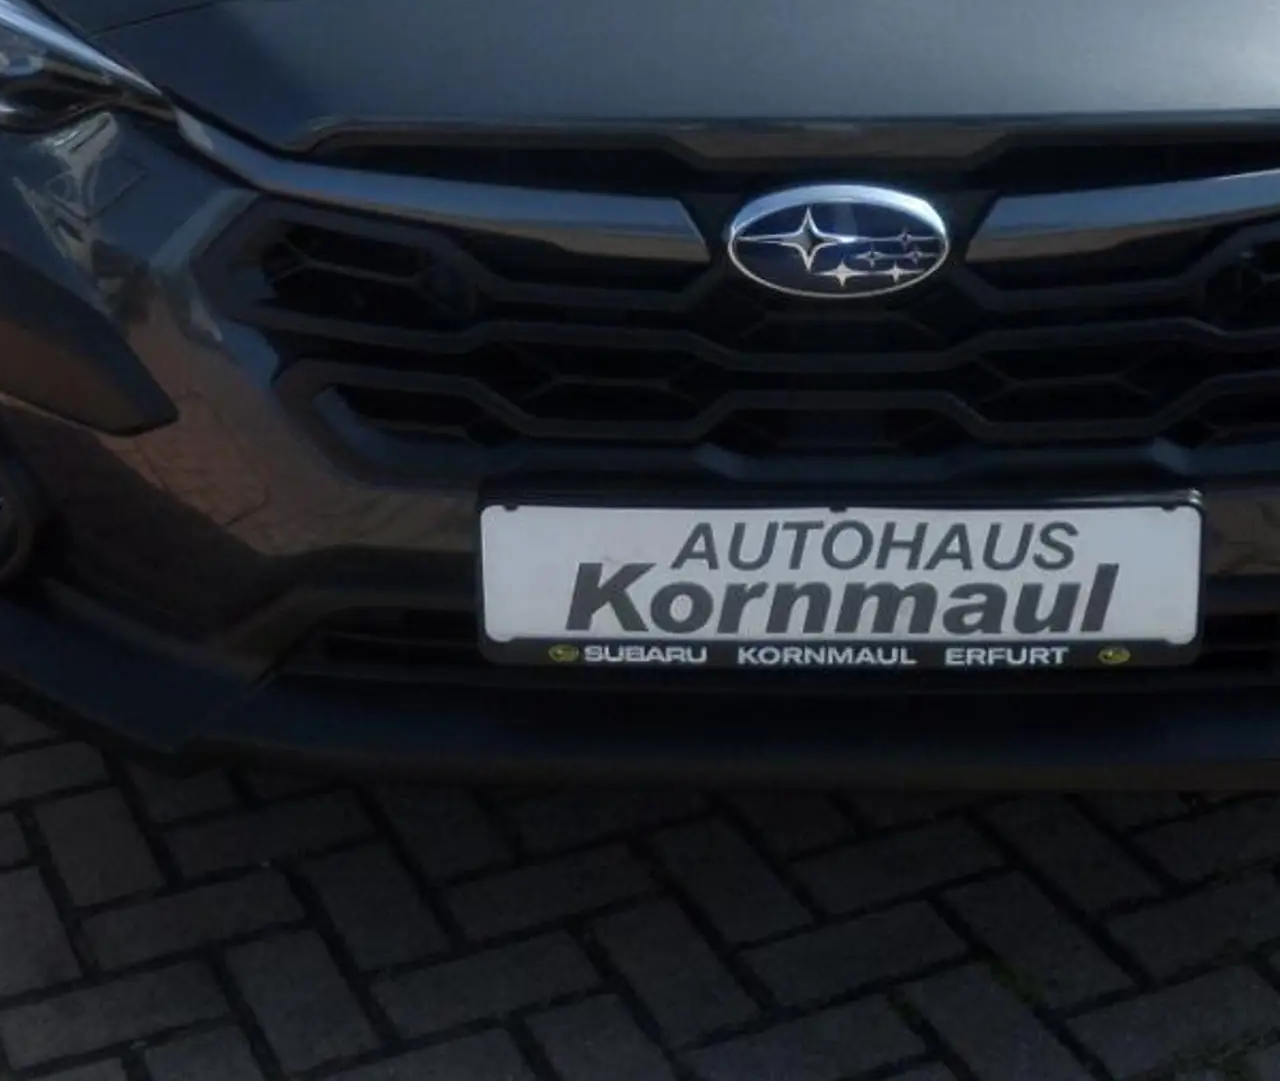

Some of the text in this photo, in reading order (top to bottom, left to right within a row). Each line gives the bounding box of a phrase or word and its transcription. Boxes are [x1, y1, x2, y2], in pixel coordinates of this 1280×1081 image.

[670, 521, 1079, 571] AUTOHAUS
[565, 562, 1119, 636] Kornmaul
[584, 645, 1069, 666] SUBARU KORNMAUL ERFURT
